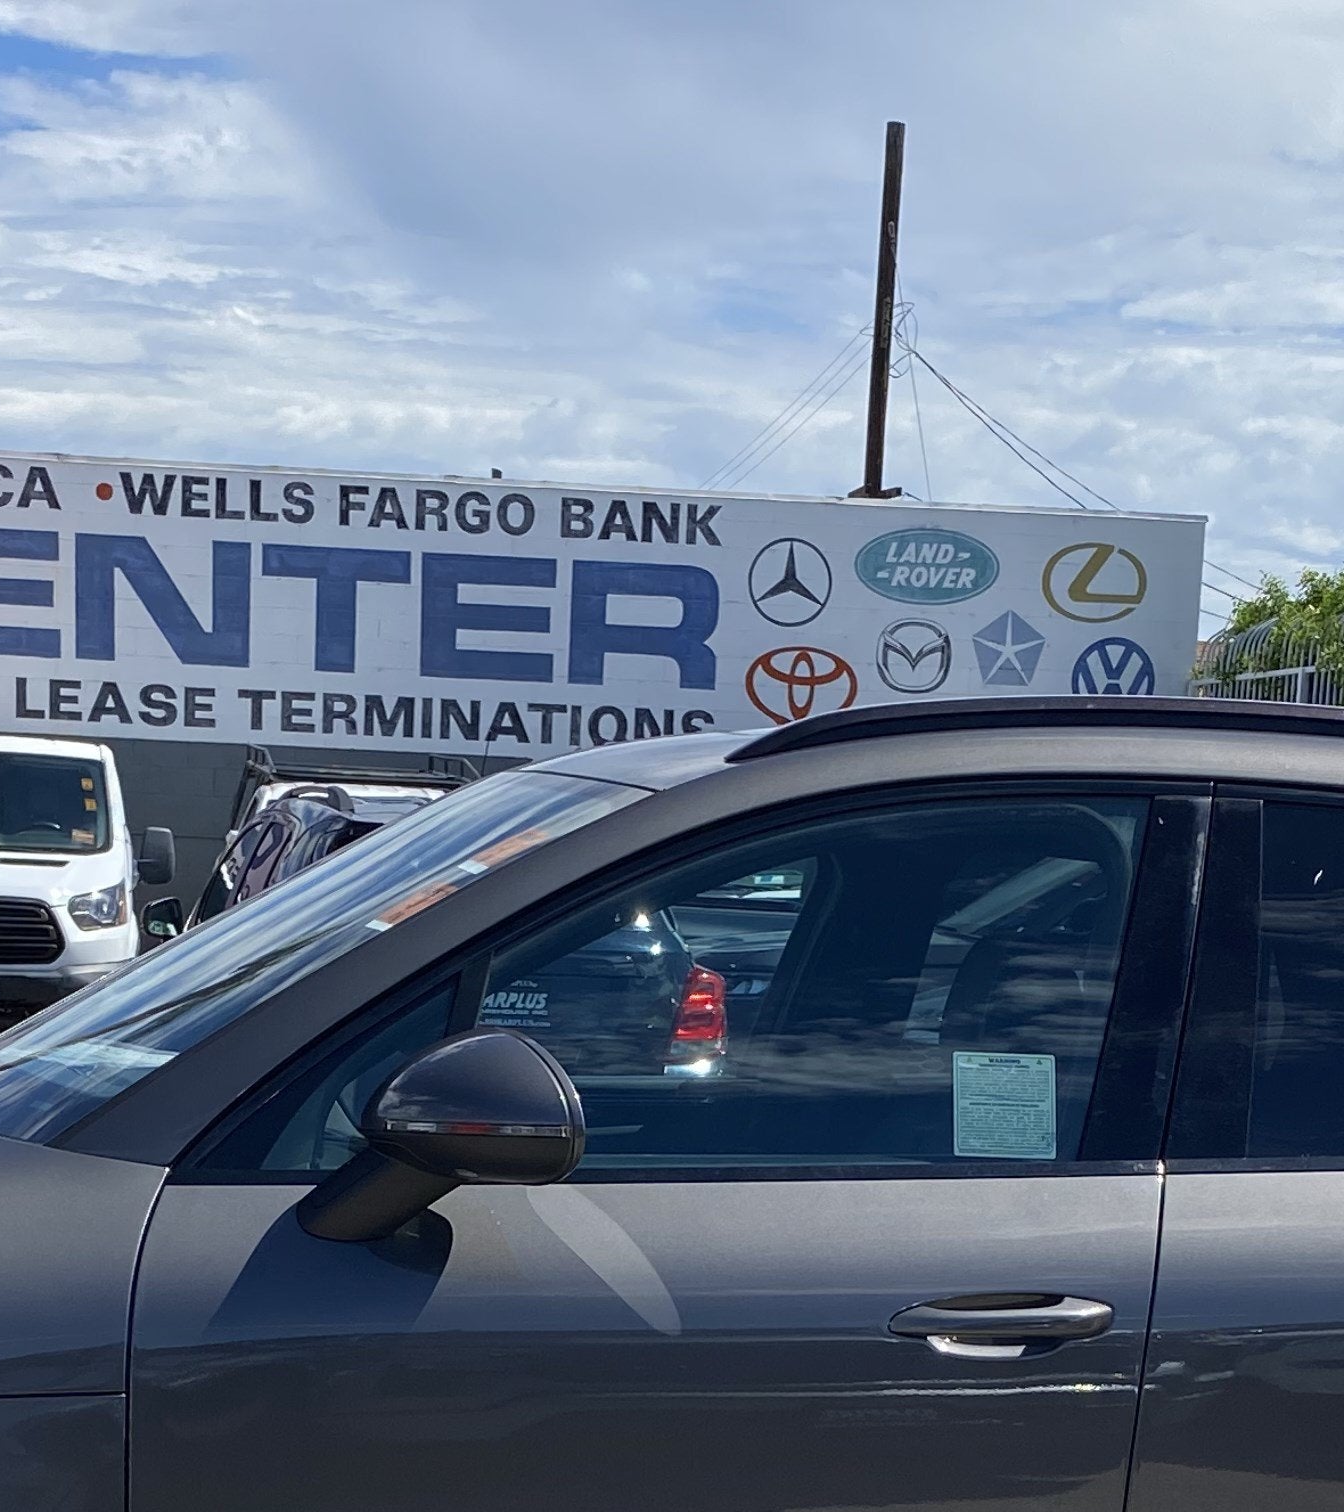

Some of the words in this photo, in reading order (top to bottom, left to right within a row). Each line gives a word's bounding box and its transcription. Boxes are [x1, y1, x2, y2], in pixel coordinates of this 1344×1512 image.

[119, 471, 316, 524] WELLS
[338, 484, 536, 537] FARGO
[560, 497, 724, 547] BANK
[886, 541, 956, 564] LAND
[890, 565, 977, 589] ROVER
[15, 676, 217, 729] LEASE
[483, 992, 548, 1009] ARPLUS
